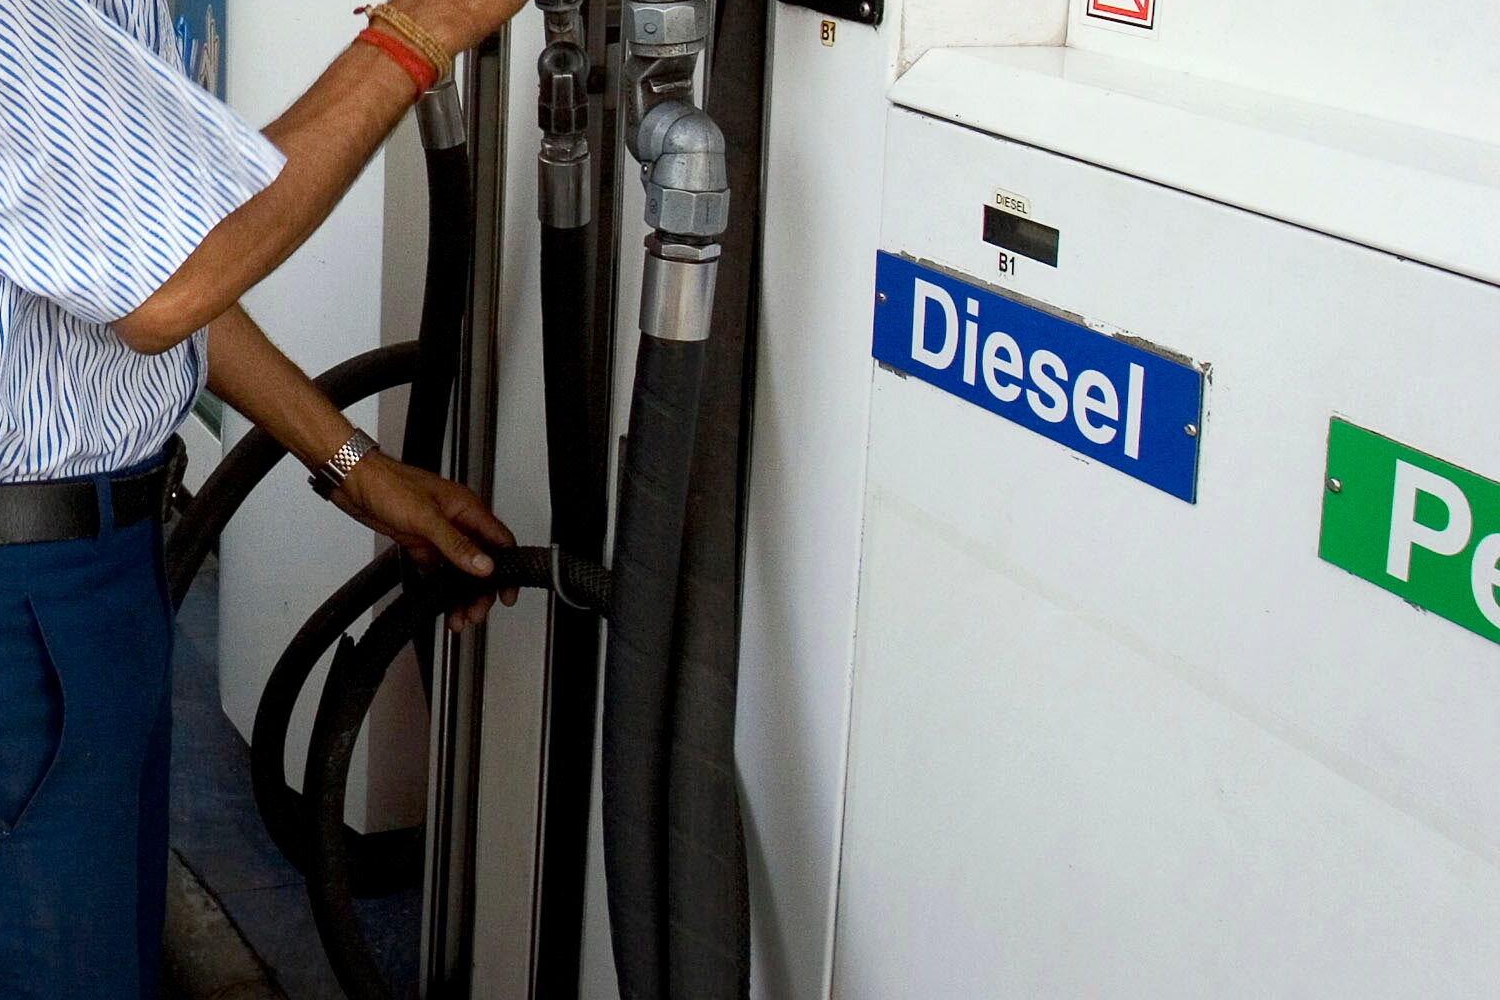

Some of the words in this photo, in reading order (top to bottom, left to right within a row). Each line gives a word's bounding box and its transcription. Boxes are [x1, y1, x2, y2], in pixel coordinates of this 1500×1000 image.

[821, 23, 836, 43] B1
[996, 193, 1028, 214] DIESEL
[999, 252, 1015, 276] B1
[910, 277, 1145, 460] Diesel
